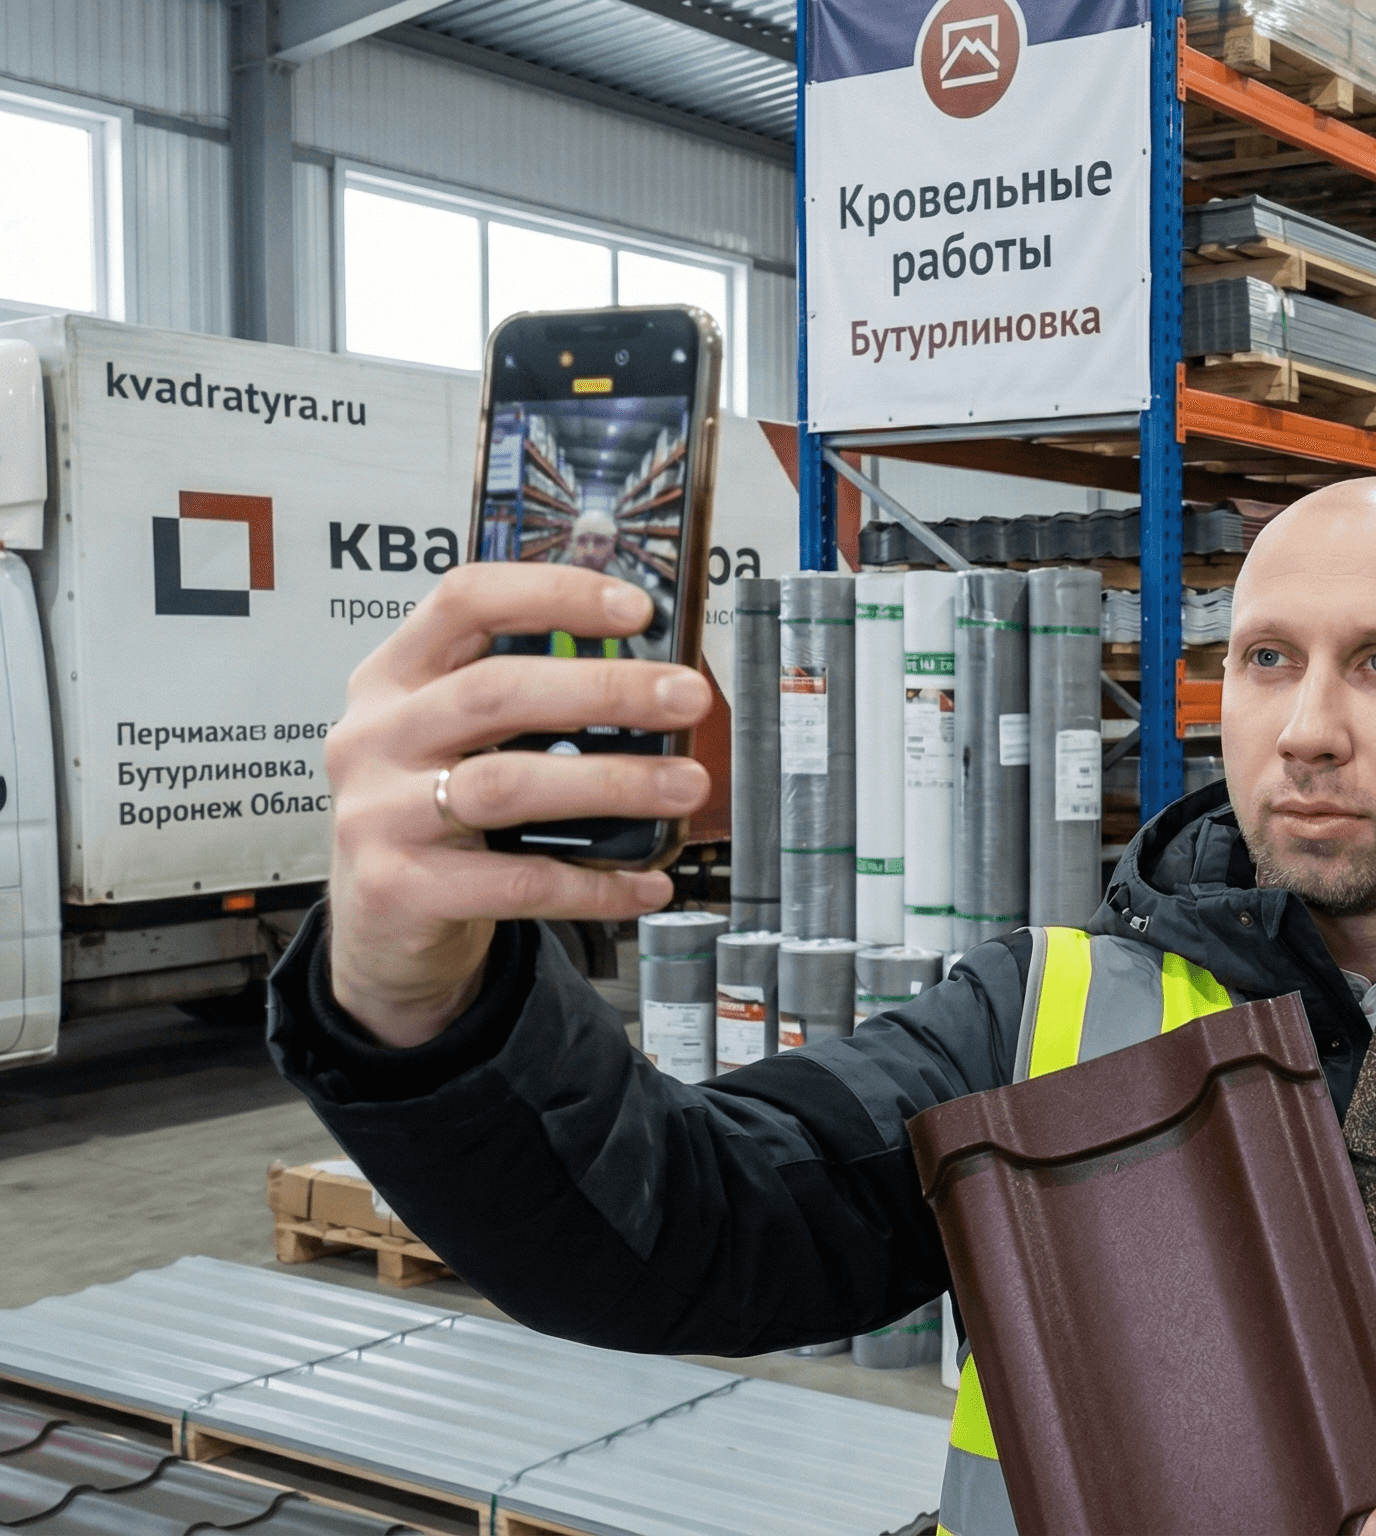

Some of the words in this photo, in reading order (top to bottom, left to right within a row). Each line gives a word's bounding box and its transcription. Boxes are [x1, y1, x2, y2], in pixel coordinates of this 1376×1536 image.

[839, 160, 1113, 236] Кровельные
[892, 232, 1052, 296] работы
[851, 306, 1101, 363] Бутурлиновка
[106, 362, 366, 426] kvadratyra.ru
[118, 759, 314, 791] Бутурлиновка,
[120, 800, 243, 829] Воронеж
[251, 792, 333, 816] Облас
